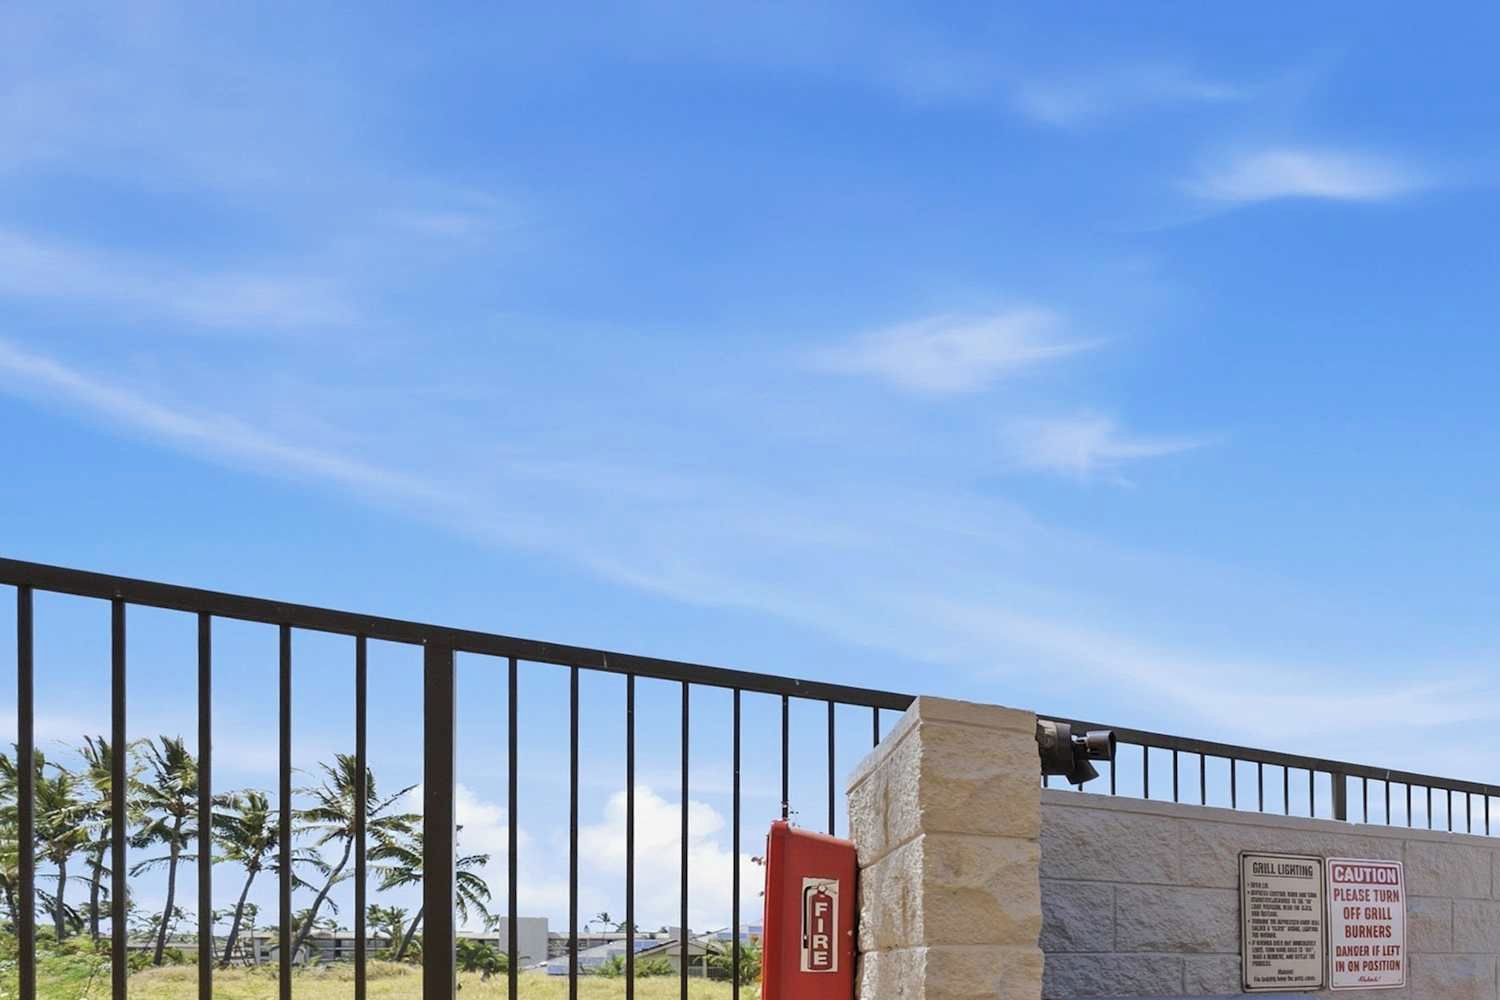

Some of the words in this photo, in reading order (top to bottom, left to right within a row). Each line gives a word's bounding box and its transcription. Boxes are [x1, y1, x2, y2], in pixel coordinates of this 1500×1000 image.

[1253, 862, 1276, 874] GRILL
[1278, 864, 1313, 876] LIGHTING
[1334, 866, 1396, 883] CAUTION
[1334, 888, 1371, 902] PLEASE
[1373, 889, 1400, 903] TURN
[1343, 906, 1361, 920] OFF
[1364, 907, 1393, 920] GRILL
[813, 902, 829, 966] FIRE
[1345, 925, 1392, 938] BURNERS
[1336, 945, 1369, 957] DANGER
[1372, 946, 1380, 956] IF
[1383, 945, 1400, 956] LEFT
[1335, 961, 1345, 972] IN
[1347, 960, 1360, 972] ON
[1362, 960, 1401, 972] POSITION
